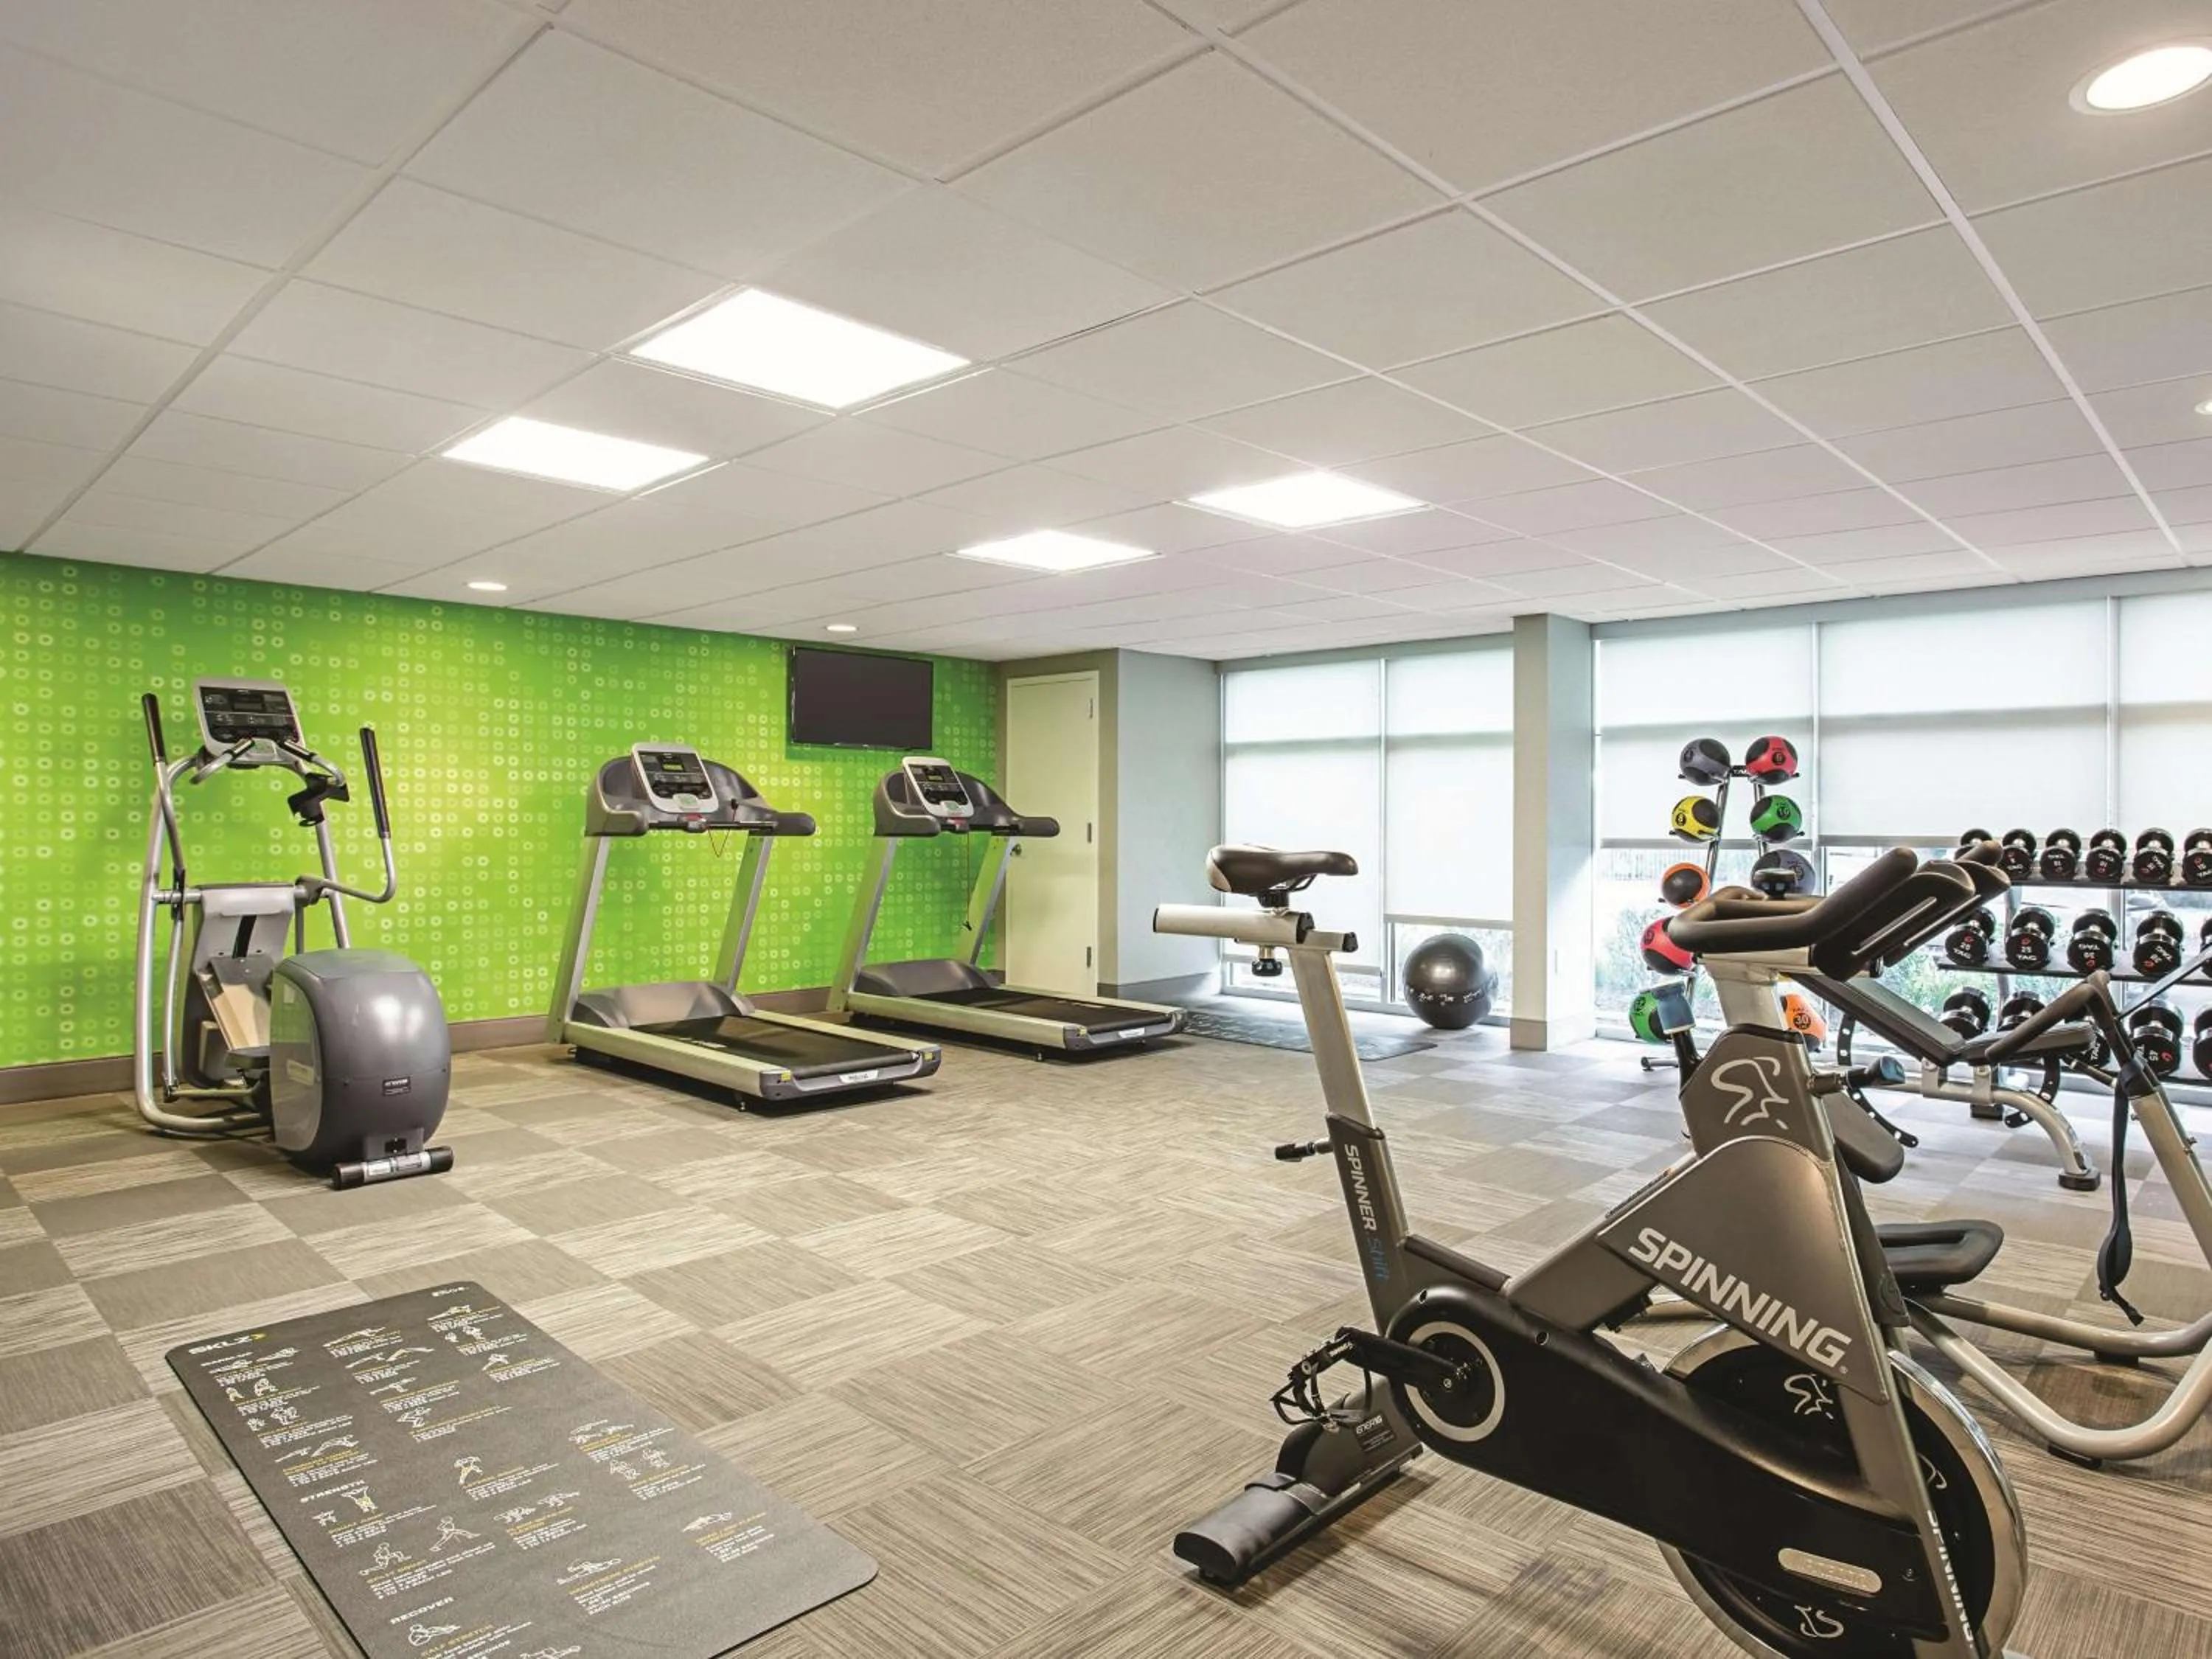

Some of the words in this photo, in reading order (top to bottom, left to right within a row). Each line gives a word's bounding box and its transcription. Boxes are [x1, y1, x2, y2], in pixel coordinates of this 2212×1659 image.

[1344, 1144, 1377, 1231] SPINNER
[1628, 1227, 1852, 1368] SPINNING
[389, 1596, 455, 1625] RECOVER
